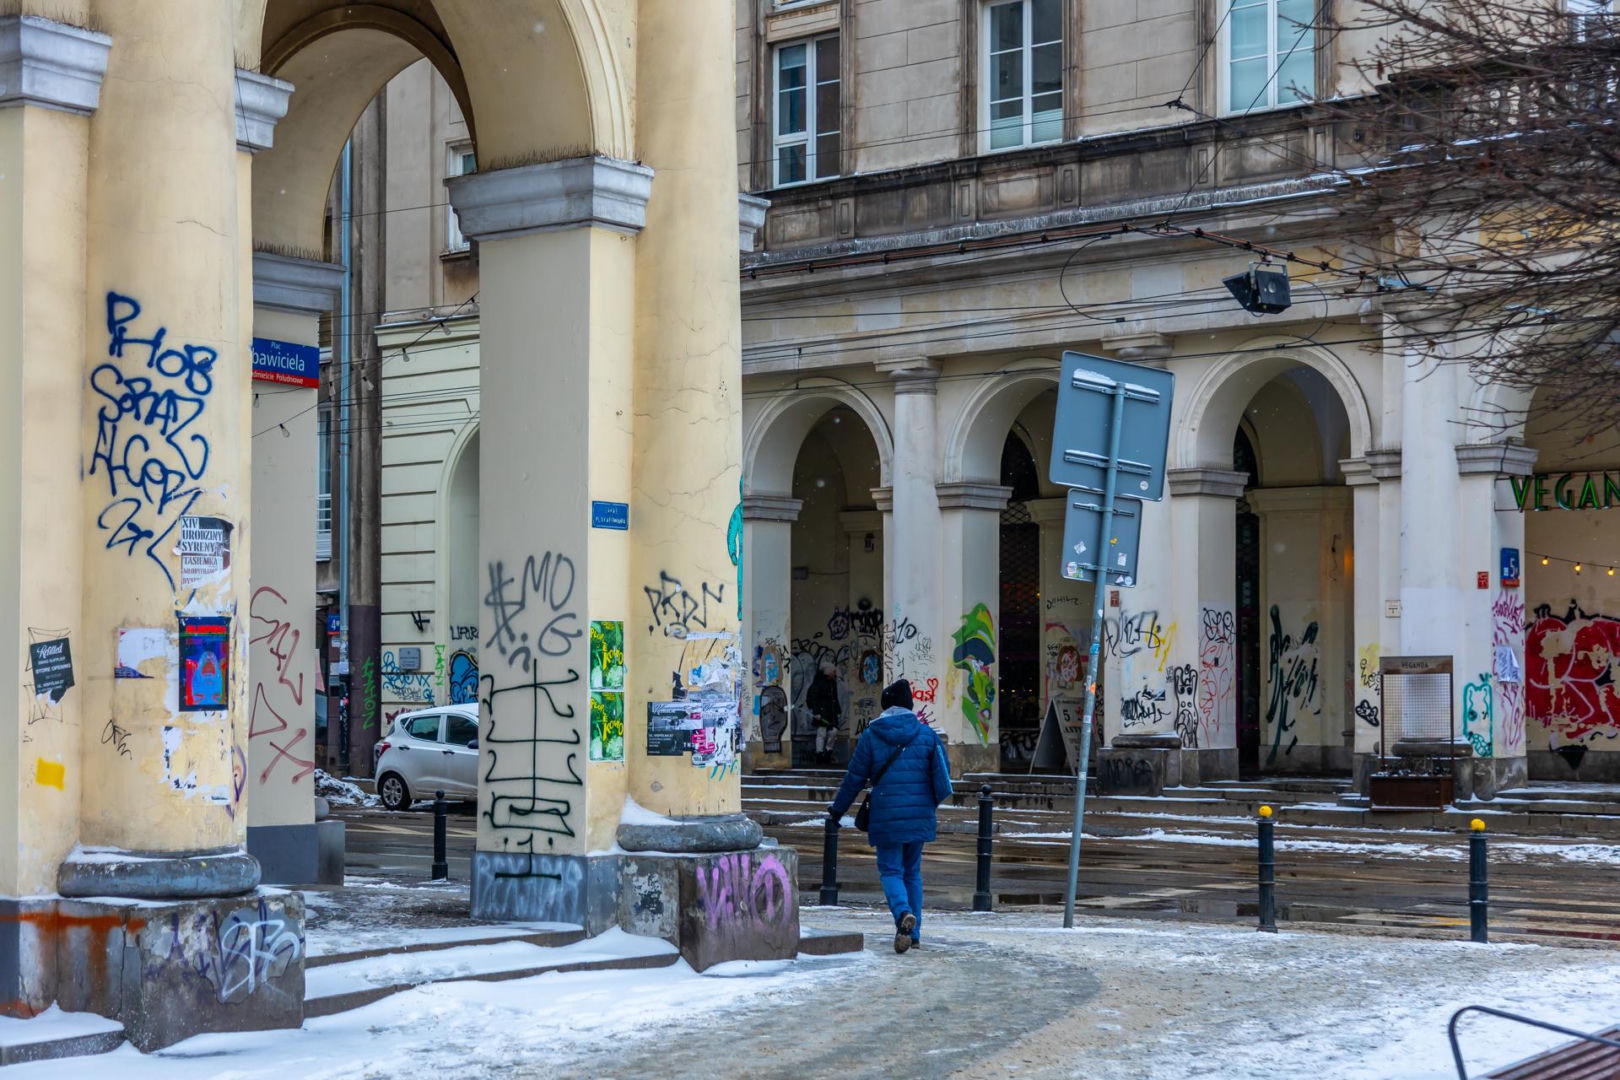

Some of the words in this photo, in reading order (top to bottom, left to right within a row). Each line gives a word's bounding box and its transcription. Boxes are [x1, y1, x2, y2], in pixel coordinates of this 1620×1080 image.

[182, 518, 198, 529] XIV
[182, 529, 222, 541] URODZINY
[181, 541, 216, 552] SYRENY
